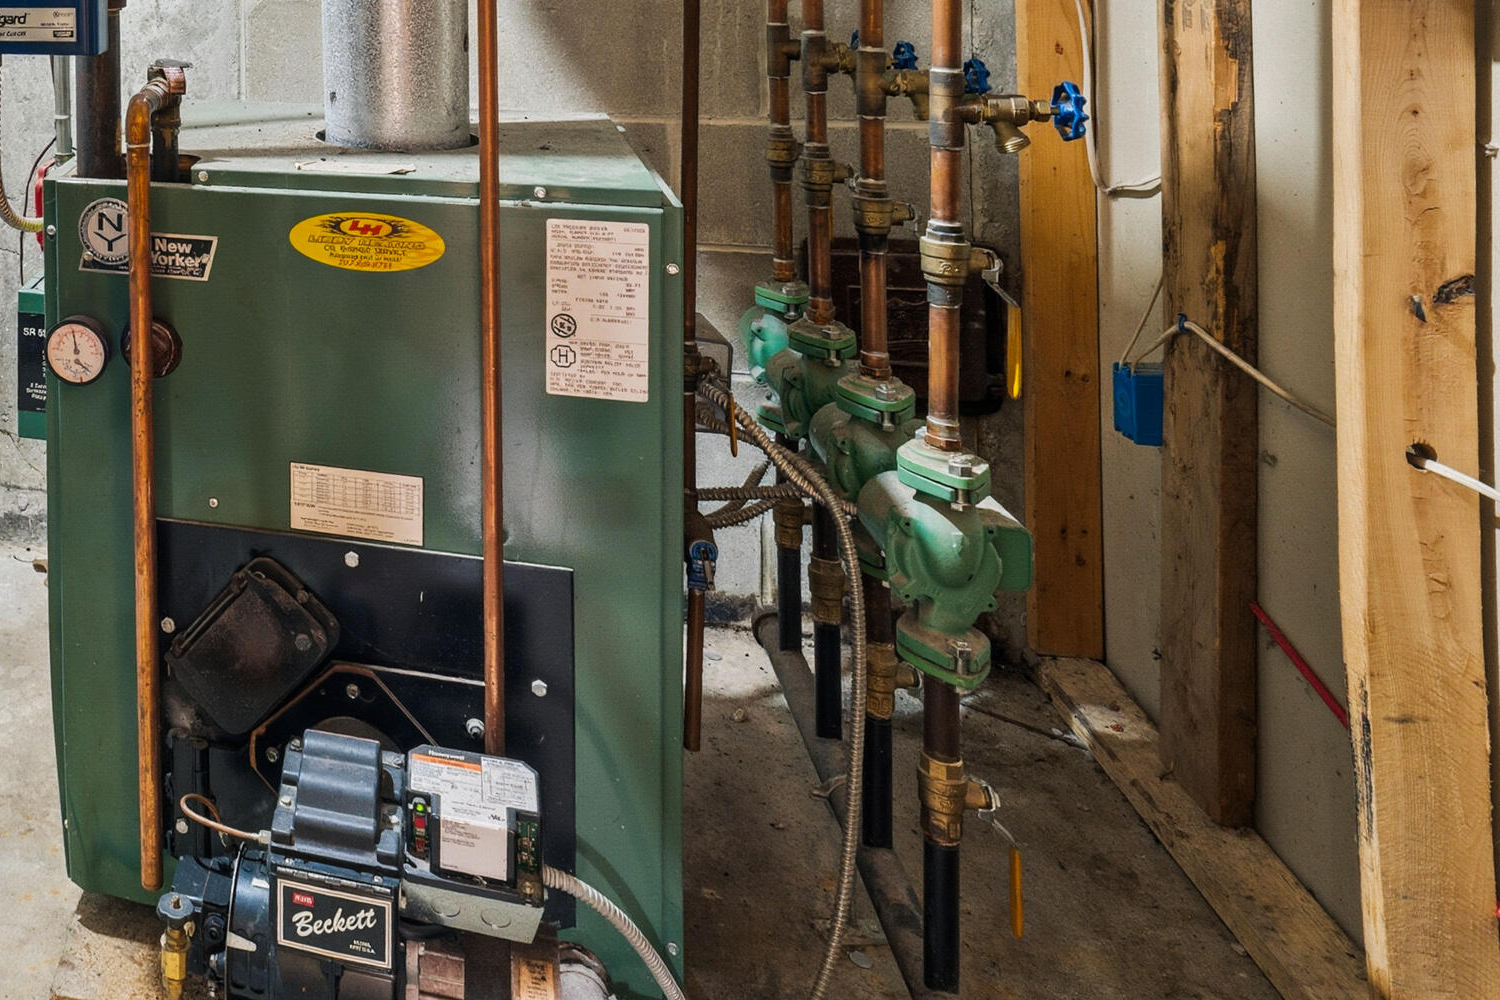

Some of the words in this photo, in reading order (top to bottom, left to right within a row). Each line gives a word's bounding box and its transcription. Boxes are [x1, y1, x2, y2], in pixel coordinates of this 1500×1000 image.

[98, 211, 123, 232] N
[93, 231, 127, 252] Y
[154, 238, 192, 254] New
[23, 327, 36, 336] SR
[292, 907, 377, 937] Beckett
